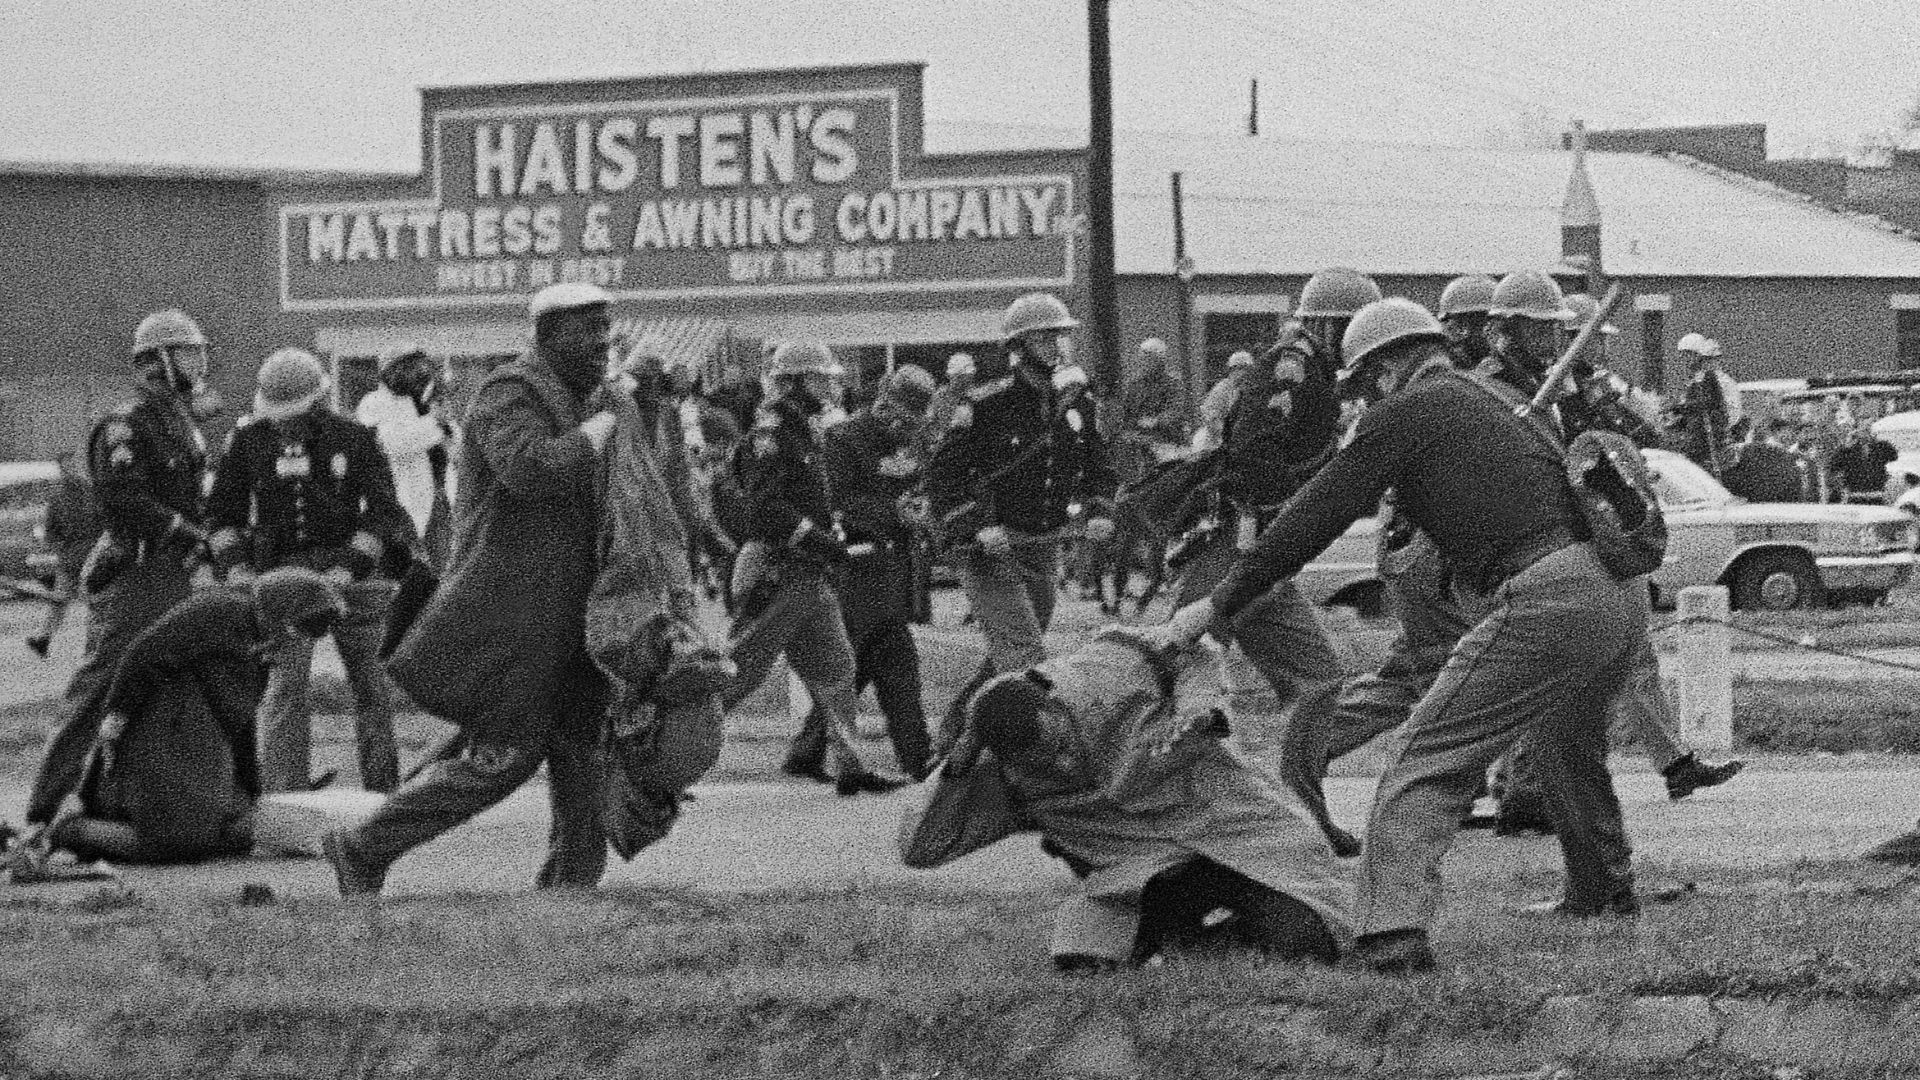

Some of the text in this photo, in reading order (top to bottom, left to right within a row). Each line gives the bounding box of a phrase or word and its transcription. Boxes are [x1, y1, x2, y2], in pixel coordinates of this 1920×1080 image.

[475, 104, 858, 197] HAISTEN'S
[308, 205, 562, 262] MATTRESS
[582, 202, 611, 250] &
[633, 193, 815, 249] AWNING
[837, 186, 1056, 243] COMPANY
